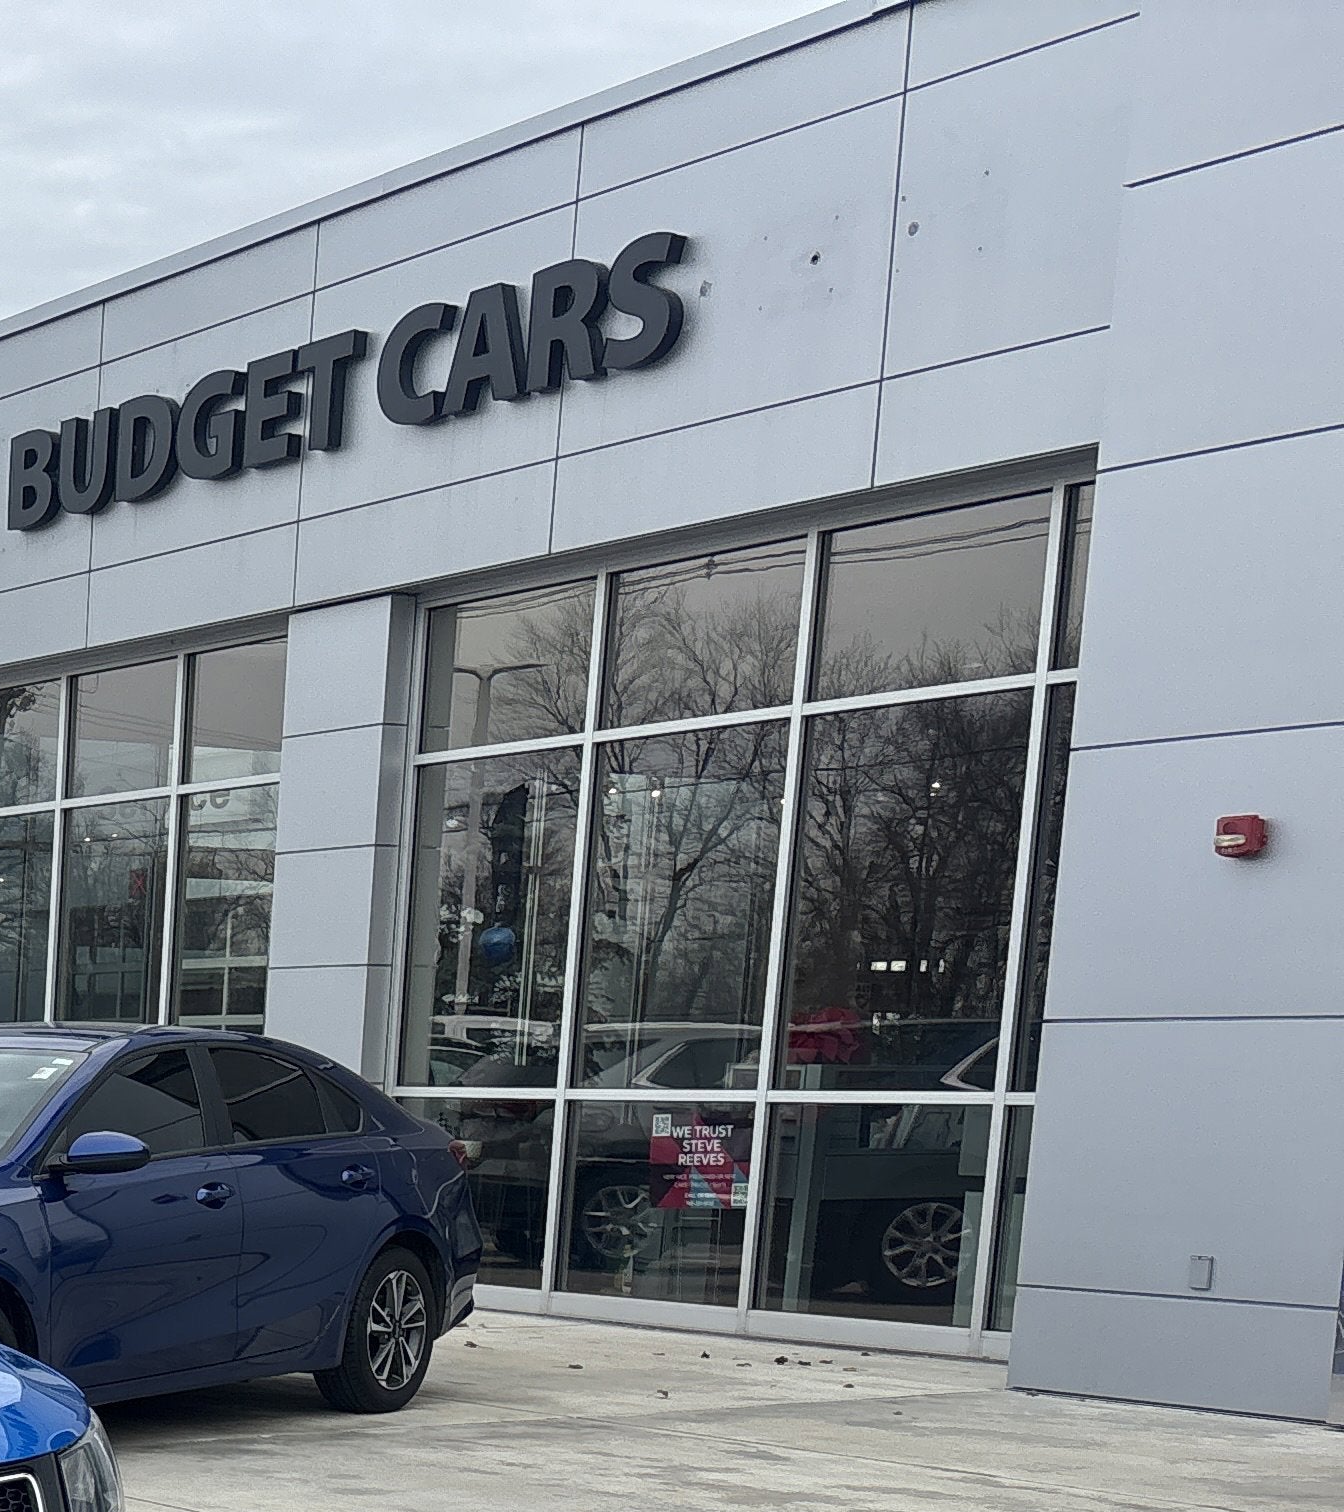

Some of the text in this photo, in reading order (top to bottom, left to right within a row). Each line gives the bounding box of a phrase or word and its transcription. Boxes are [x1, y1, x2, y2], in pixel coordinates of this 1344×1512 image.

[7, 231, 688, 531] BUDGET CARS
[671, 1124, 734, 1138] WE TRUST
[682, 1139, 722, 1152] STEVE
[678, 1152, 725, 1166] REEVES
